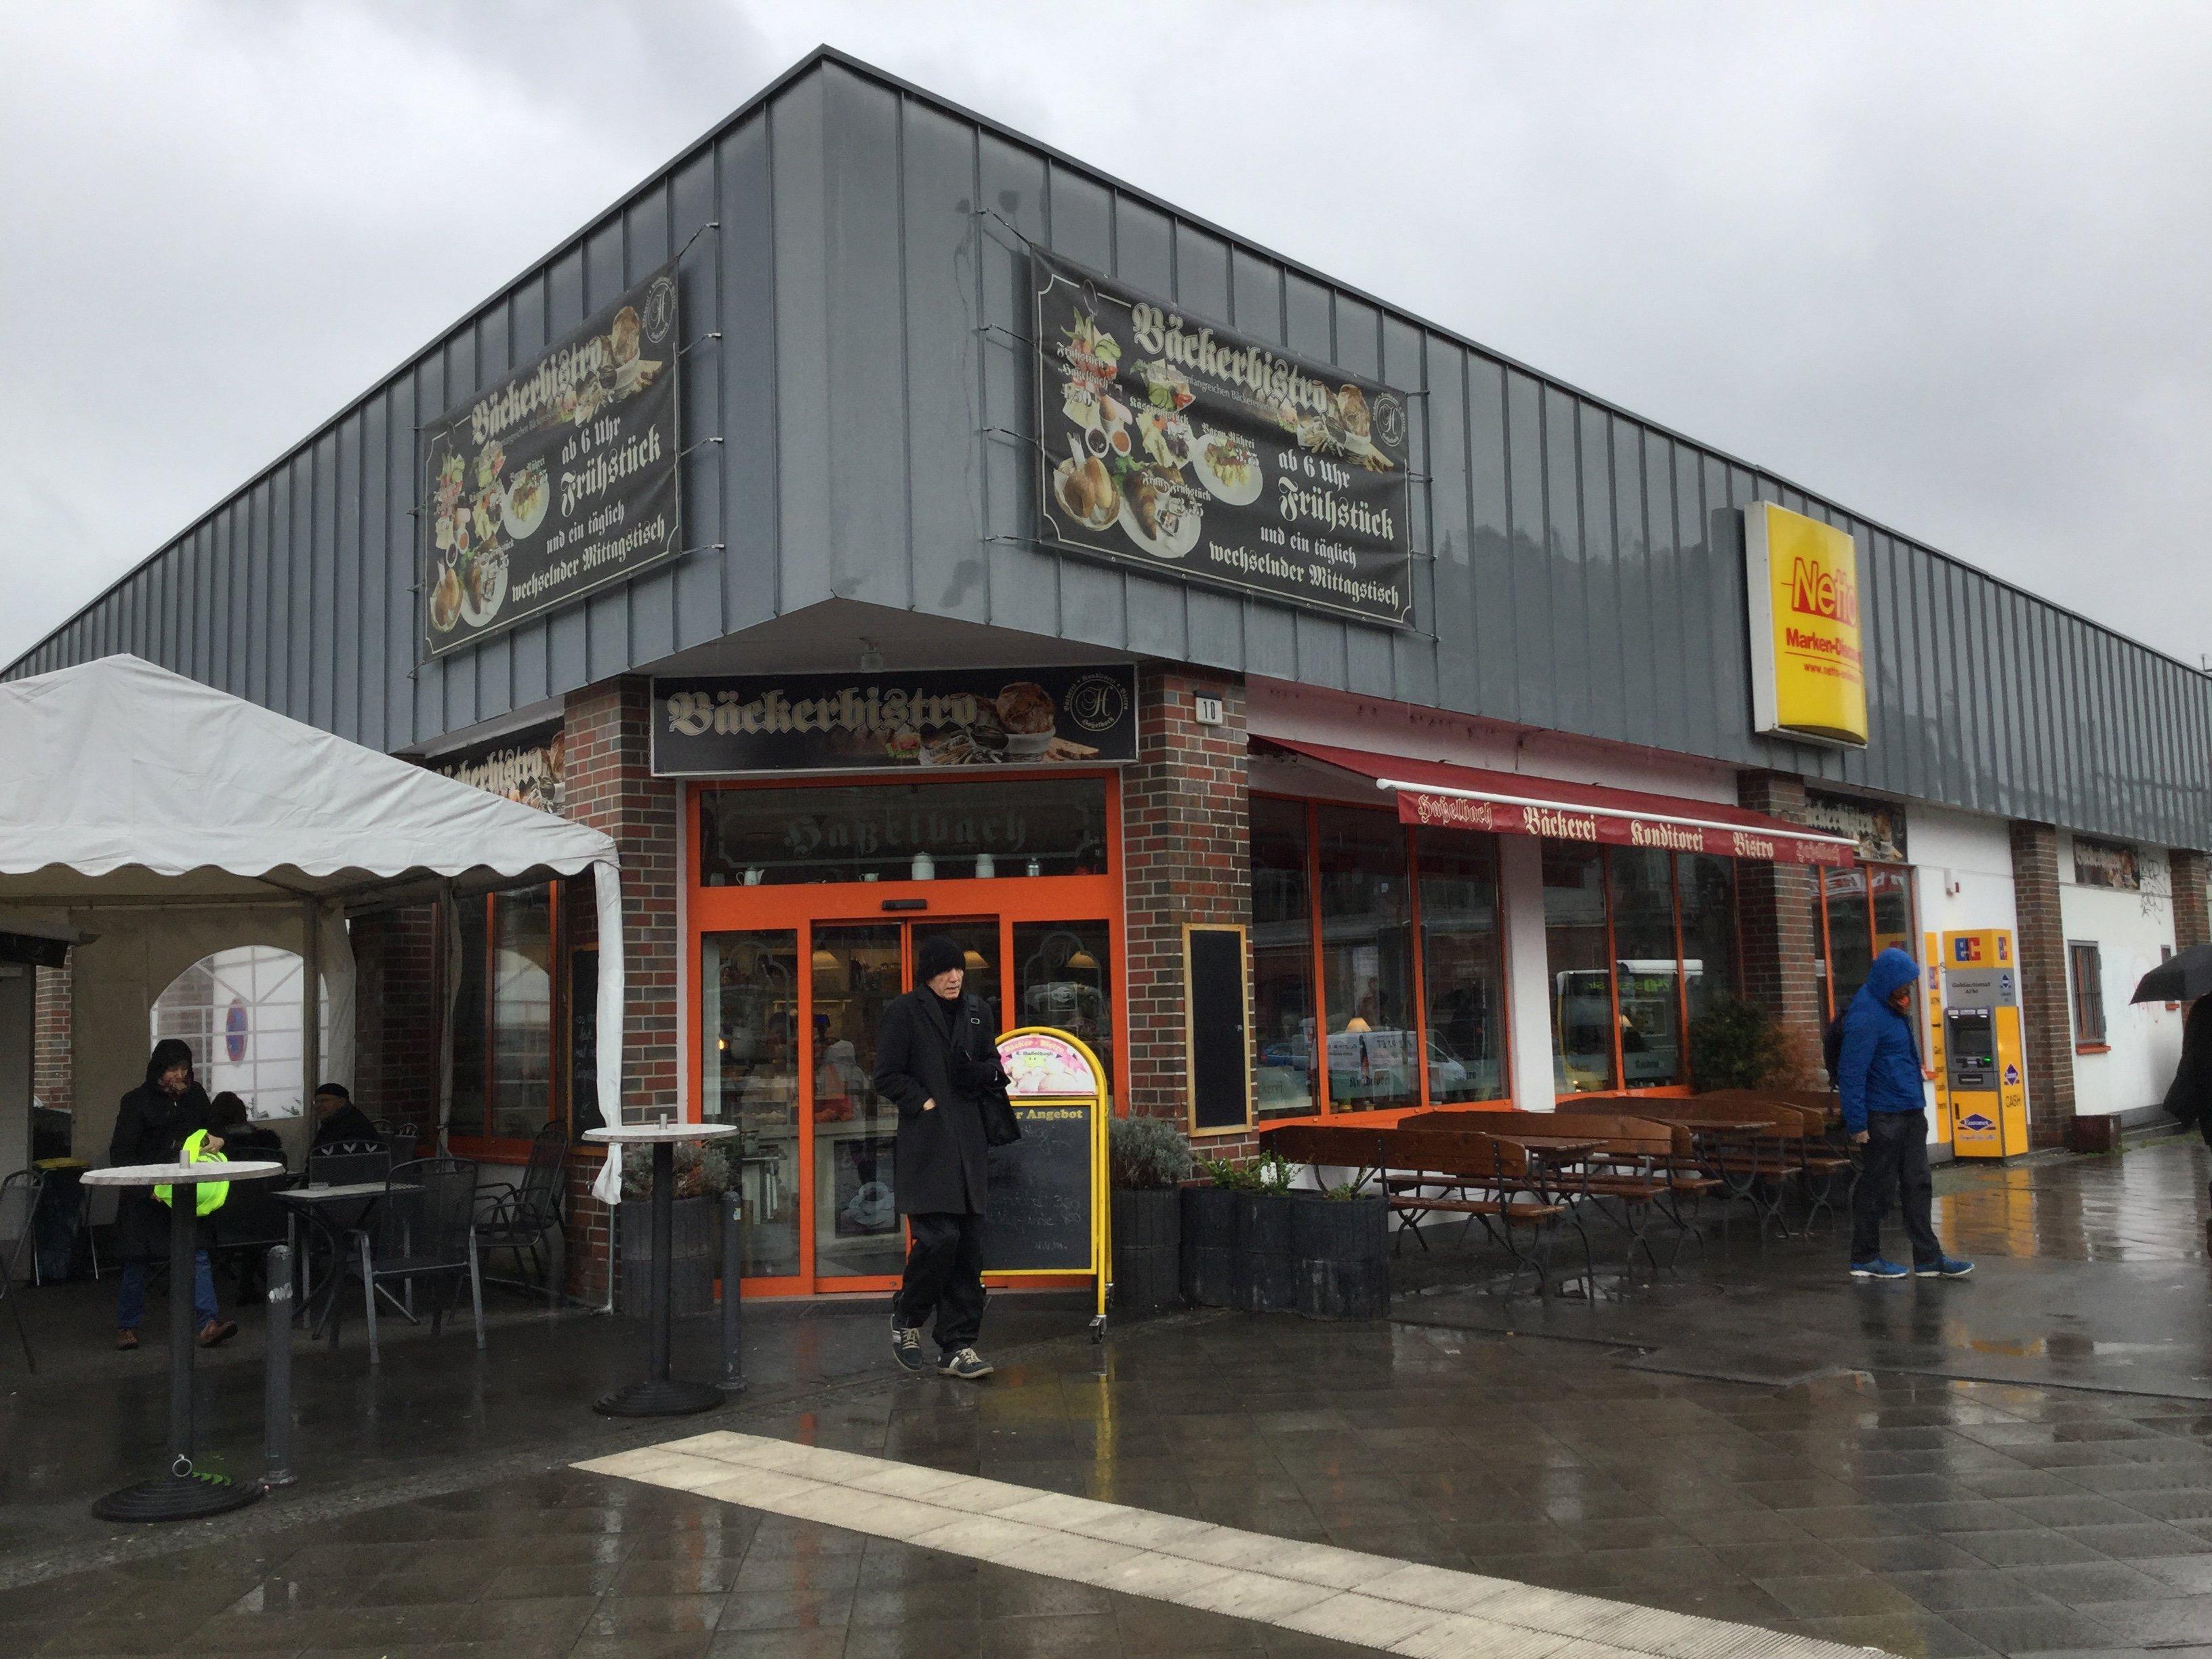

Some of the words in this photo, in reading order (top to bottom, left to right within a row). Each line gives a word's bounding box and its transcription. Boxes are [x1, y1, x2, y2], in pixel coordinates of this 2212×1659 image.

[1132, 302, 1328, 415] Bäckerbistro
[472, 336, 602, 446] Bäckerbistro
[562, 434, 577, 466] ab
[581, 428, 591, 454] 6
[594, 414, 621, 447] Uhr
[560, 423, 661, 518] Frühstück
[1279, 449, 1298, 472] ab
[1303, 455, 1315, 478] 6
[1319, 459, 1351, 492] Uhr
[546, 529, 566, 555] und
[569, 521, 585, 549] ein
[588, 498, 625, 537] täglich
[1278, 476, 1395, 541] Frühstück
[512, 557, 579, 603] wechselnder
[582, 512, 665, 572] Mittagstisch
[1209, 541, 1305, 583] wechselnder
[1309, 564, 1399, 612] Mittagstisch
[1260, 526, 1286, 546] und
[1290, 532, 1310, 554] ein
[1314, 538, 1357, 571] täglich
[1791, 556, 1858, 628] Netto
[667, 686, 978, 736] Bäckerbistro
[1203, 701, 1216, 720] 10
[1523, 806, 1597, 842] Bäckerei
[1631, 819, 1704, 853] Konditorei
[1733, 831, 1775, 860] Bistro
[1026, 1109, 1083, 1122] Angebot
